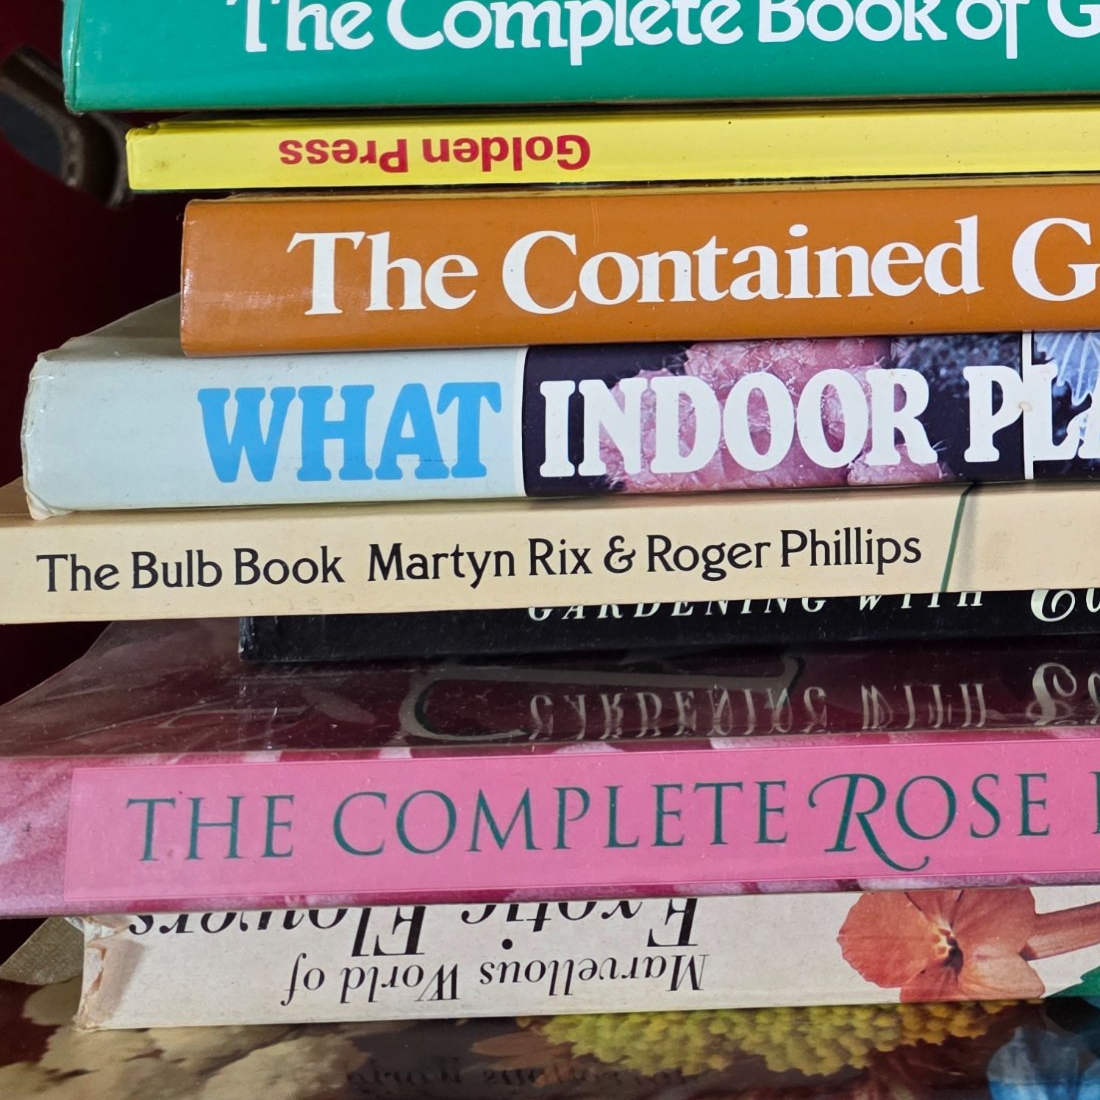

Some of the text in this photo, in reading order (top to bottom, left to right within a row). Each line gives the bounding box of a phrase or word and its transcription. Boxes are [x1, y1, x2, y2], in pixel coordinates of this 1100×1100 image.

[279, 133, 591, 172] Golden Press
[286, 230, 478, 317] The
[502, 214, 984, 314] Contained
[198, 381, 501, 483] WHAT
[539, 367, 939, 477] INDOOR
[36, 527, 922, 592] The Bulb Book Martyn Rix & Roger Phillips
[126, 794, 295, 861] THE
[331, 779, 789, 856] COMPLETE
[807, 770, 1050, 873] ROSE
[280, 953, 711, 1006] Marvellous World of
